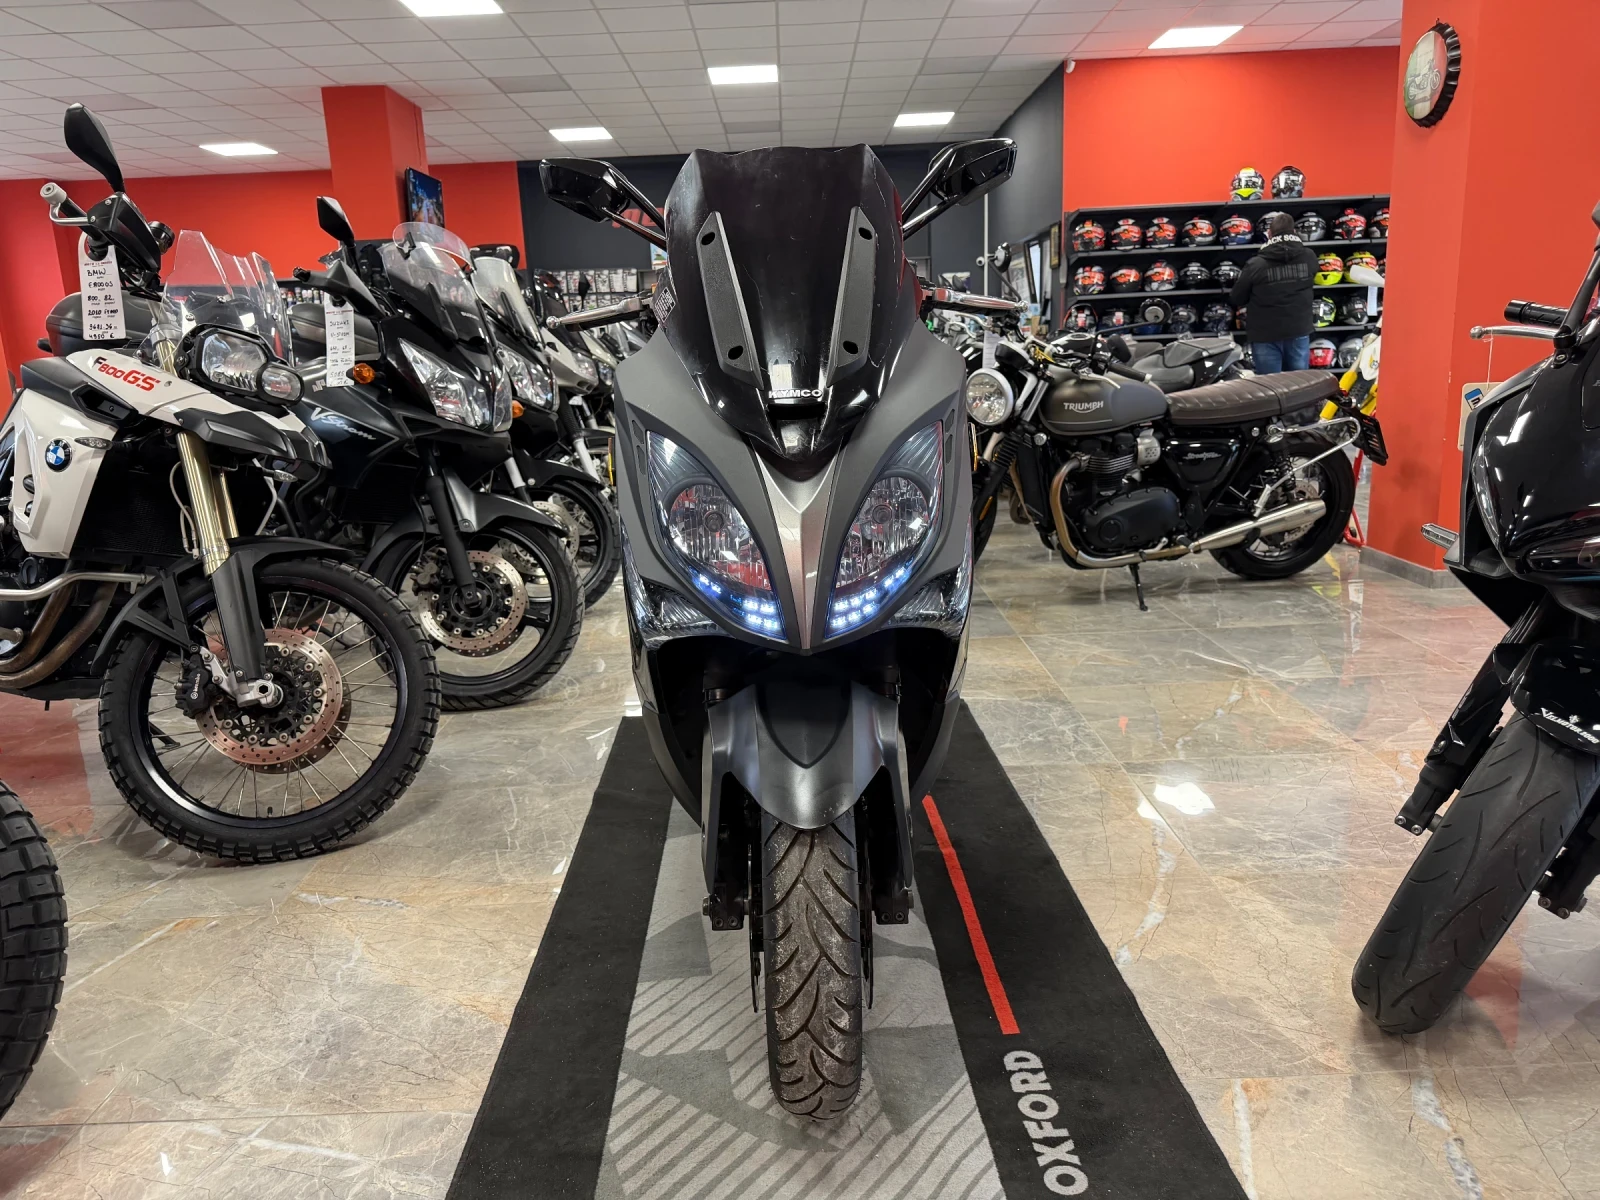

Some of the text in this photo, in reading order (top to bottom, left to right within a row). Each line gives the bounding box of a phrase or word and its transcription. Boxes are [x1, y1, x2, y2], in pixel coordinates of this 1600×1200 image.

[87, 268, 106, 277] BMW
[93, 356, 161, 392] F800GS
[768, 389, 823, 399] KYMCO
[1063, 400, 1104, 414] TRIUMPH
[1003, 1049, 1089, 1196] OXFORD
